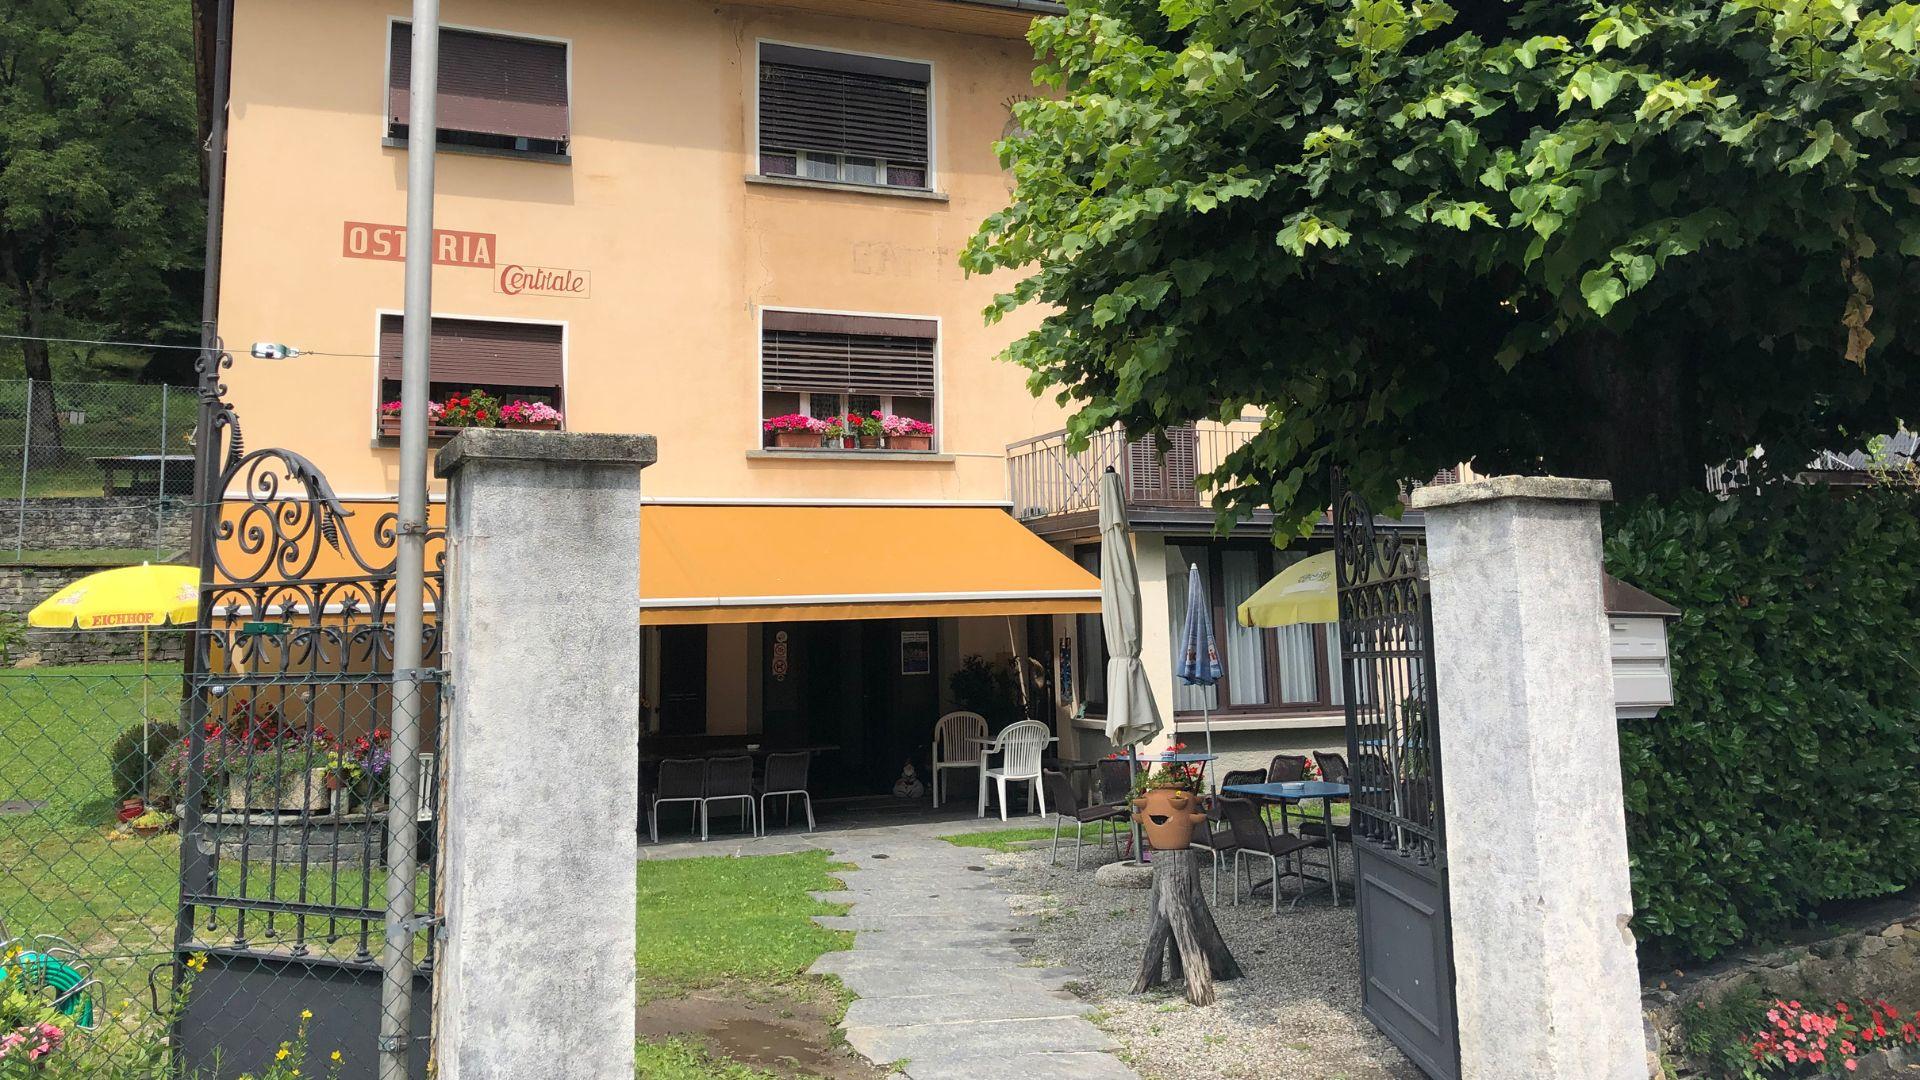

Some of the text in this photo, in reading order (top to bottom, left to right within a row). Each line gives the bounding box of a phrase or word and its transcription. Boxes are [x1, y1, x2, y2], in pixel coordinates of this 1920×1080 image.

[349, 226, 491, 265] OSTRIA
[500, 264, 585, 296] Centrale
[92, 612, 154, 627] EICHHOF
